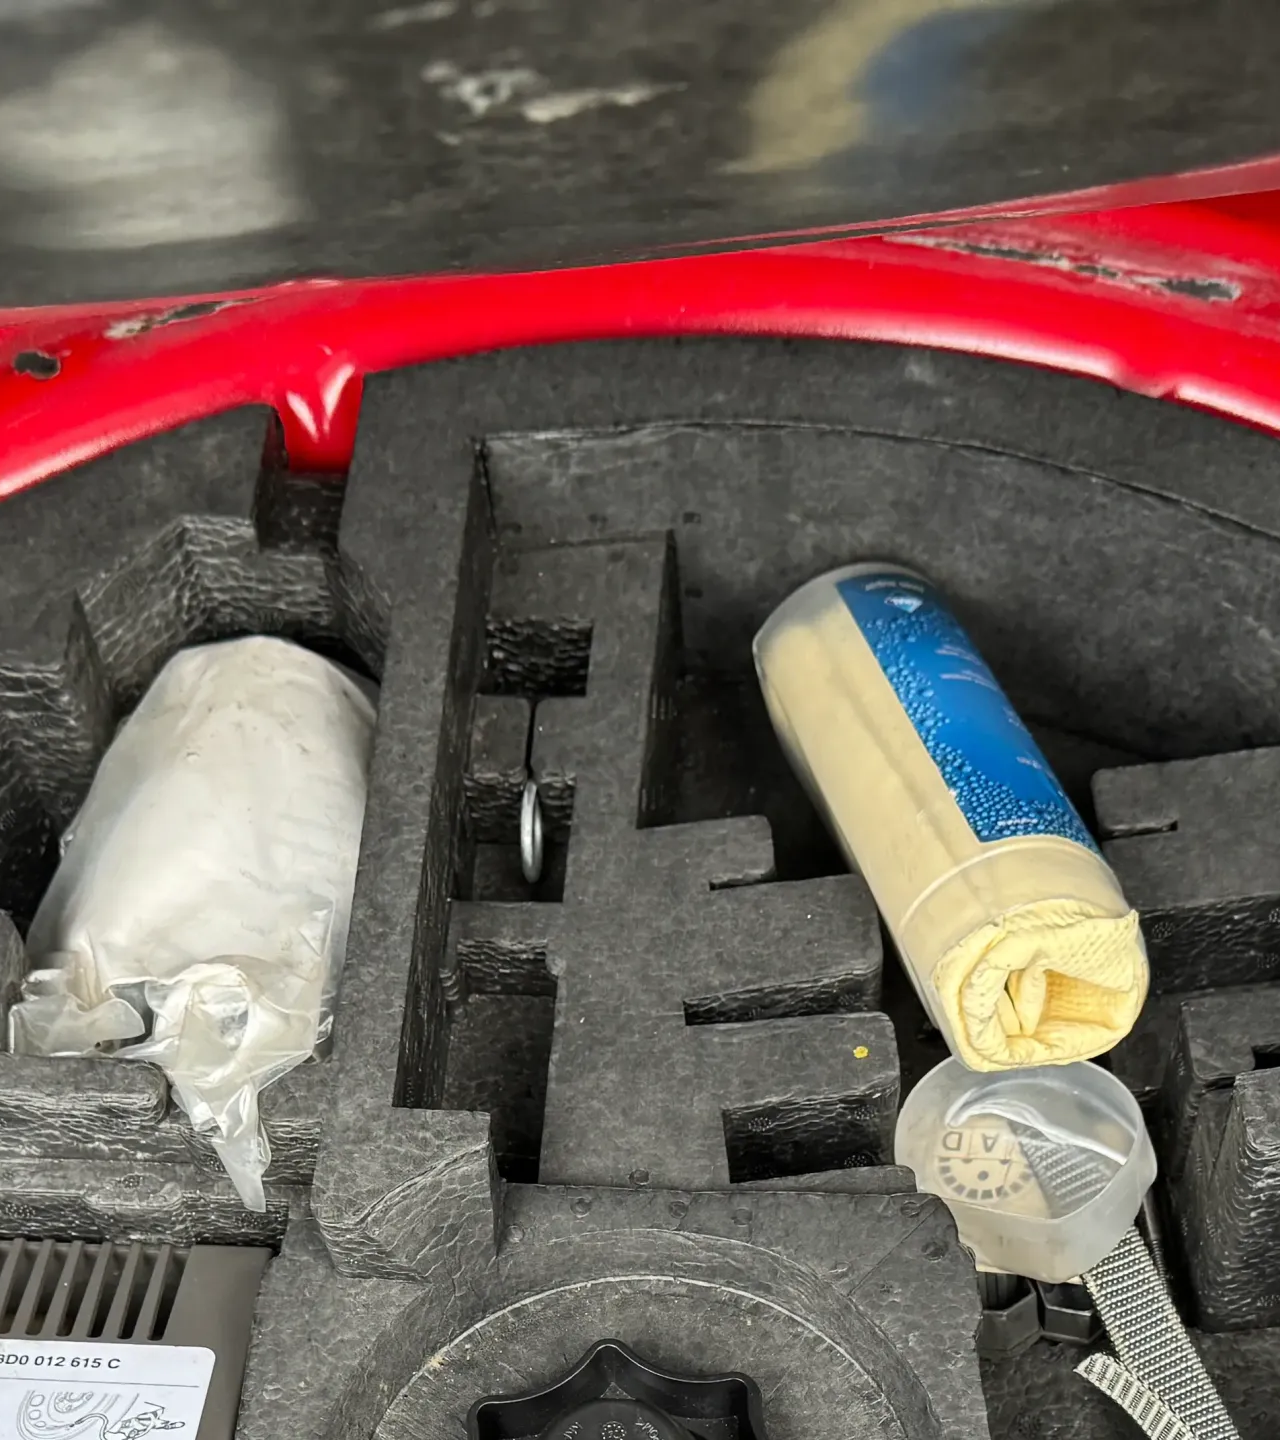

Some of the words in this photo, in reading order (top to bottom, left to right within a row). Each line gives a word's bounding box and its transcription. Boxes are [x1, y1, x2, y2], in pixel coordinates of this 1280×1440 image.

[34, 1356, 66, 1366] 012
[71, 1357, 102, 1368] 615
[108, 1358, 121, 1369] C
